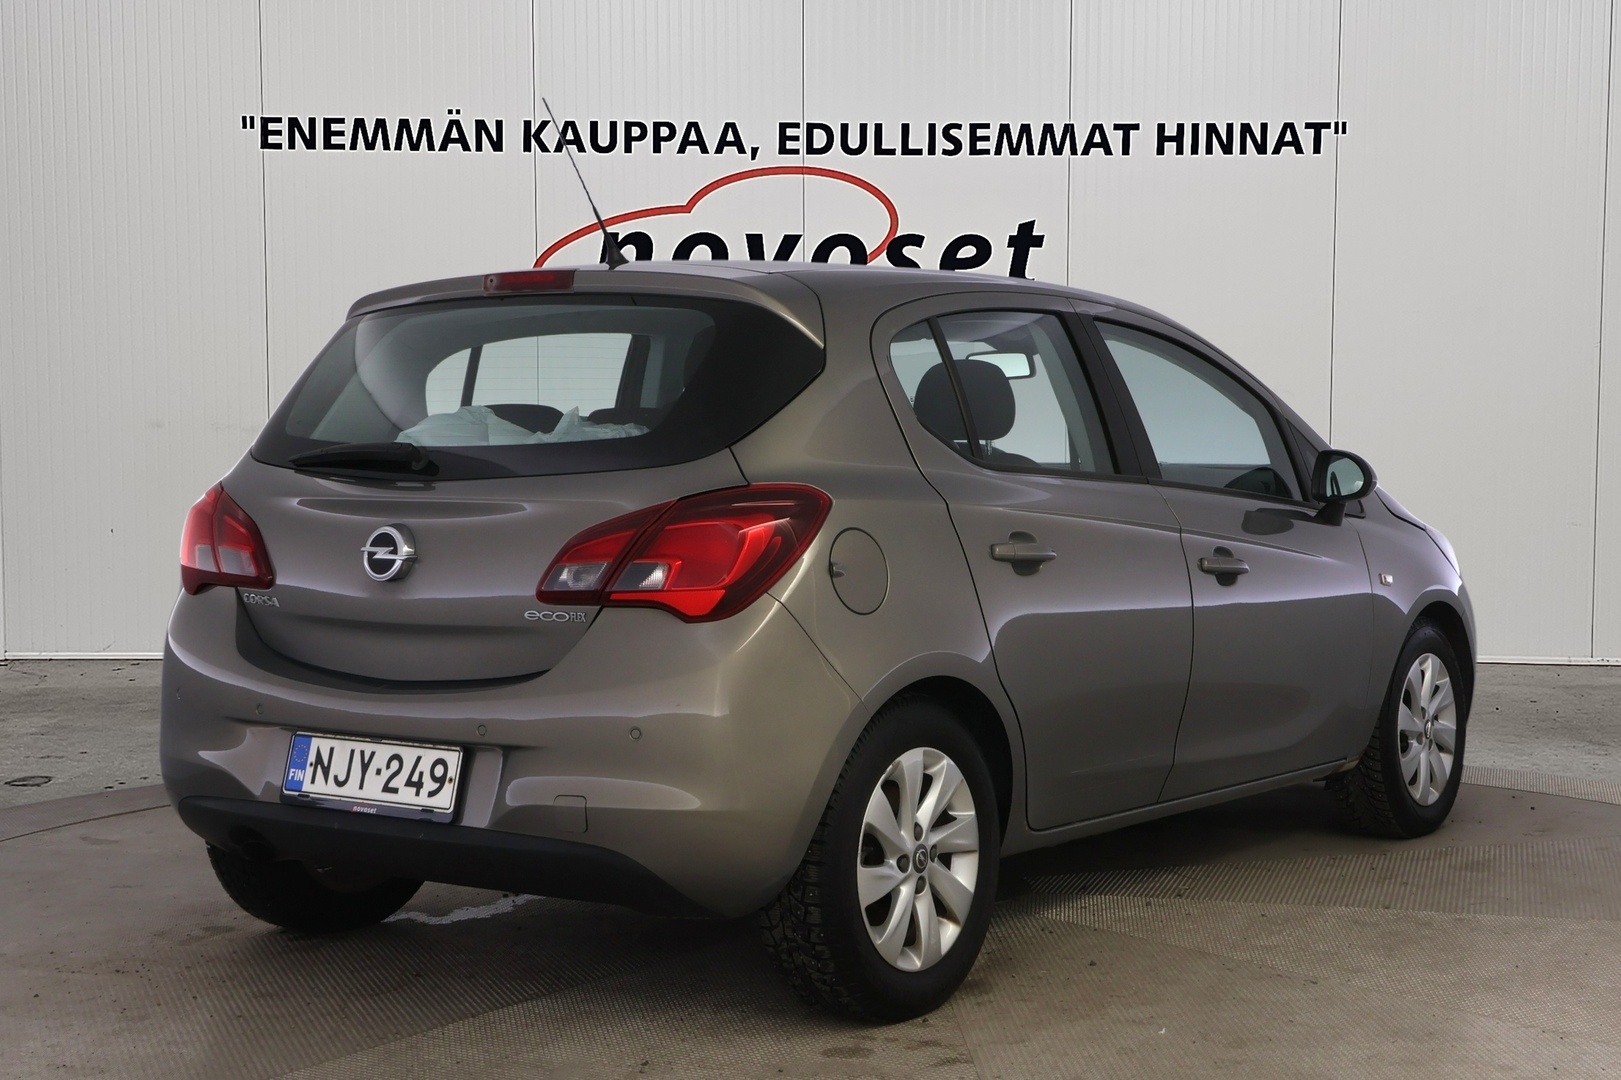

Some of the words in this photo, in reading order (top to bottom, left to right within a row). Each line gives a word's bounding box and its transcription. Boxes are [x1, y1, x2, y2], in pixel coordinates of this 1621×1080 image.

[241, 108, 504, 152] "ENEMMÄN
[522, 119, 761, 161] KAUPPAA,
[778, 122, 1140, 156] EDULLISEMMAT
[1156, 121, 1347, 156] HINNAT"
[243, 593, 280, 607] CORSA
[288, 768, 305, 782] FIN
